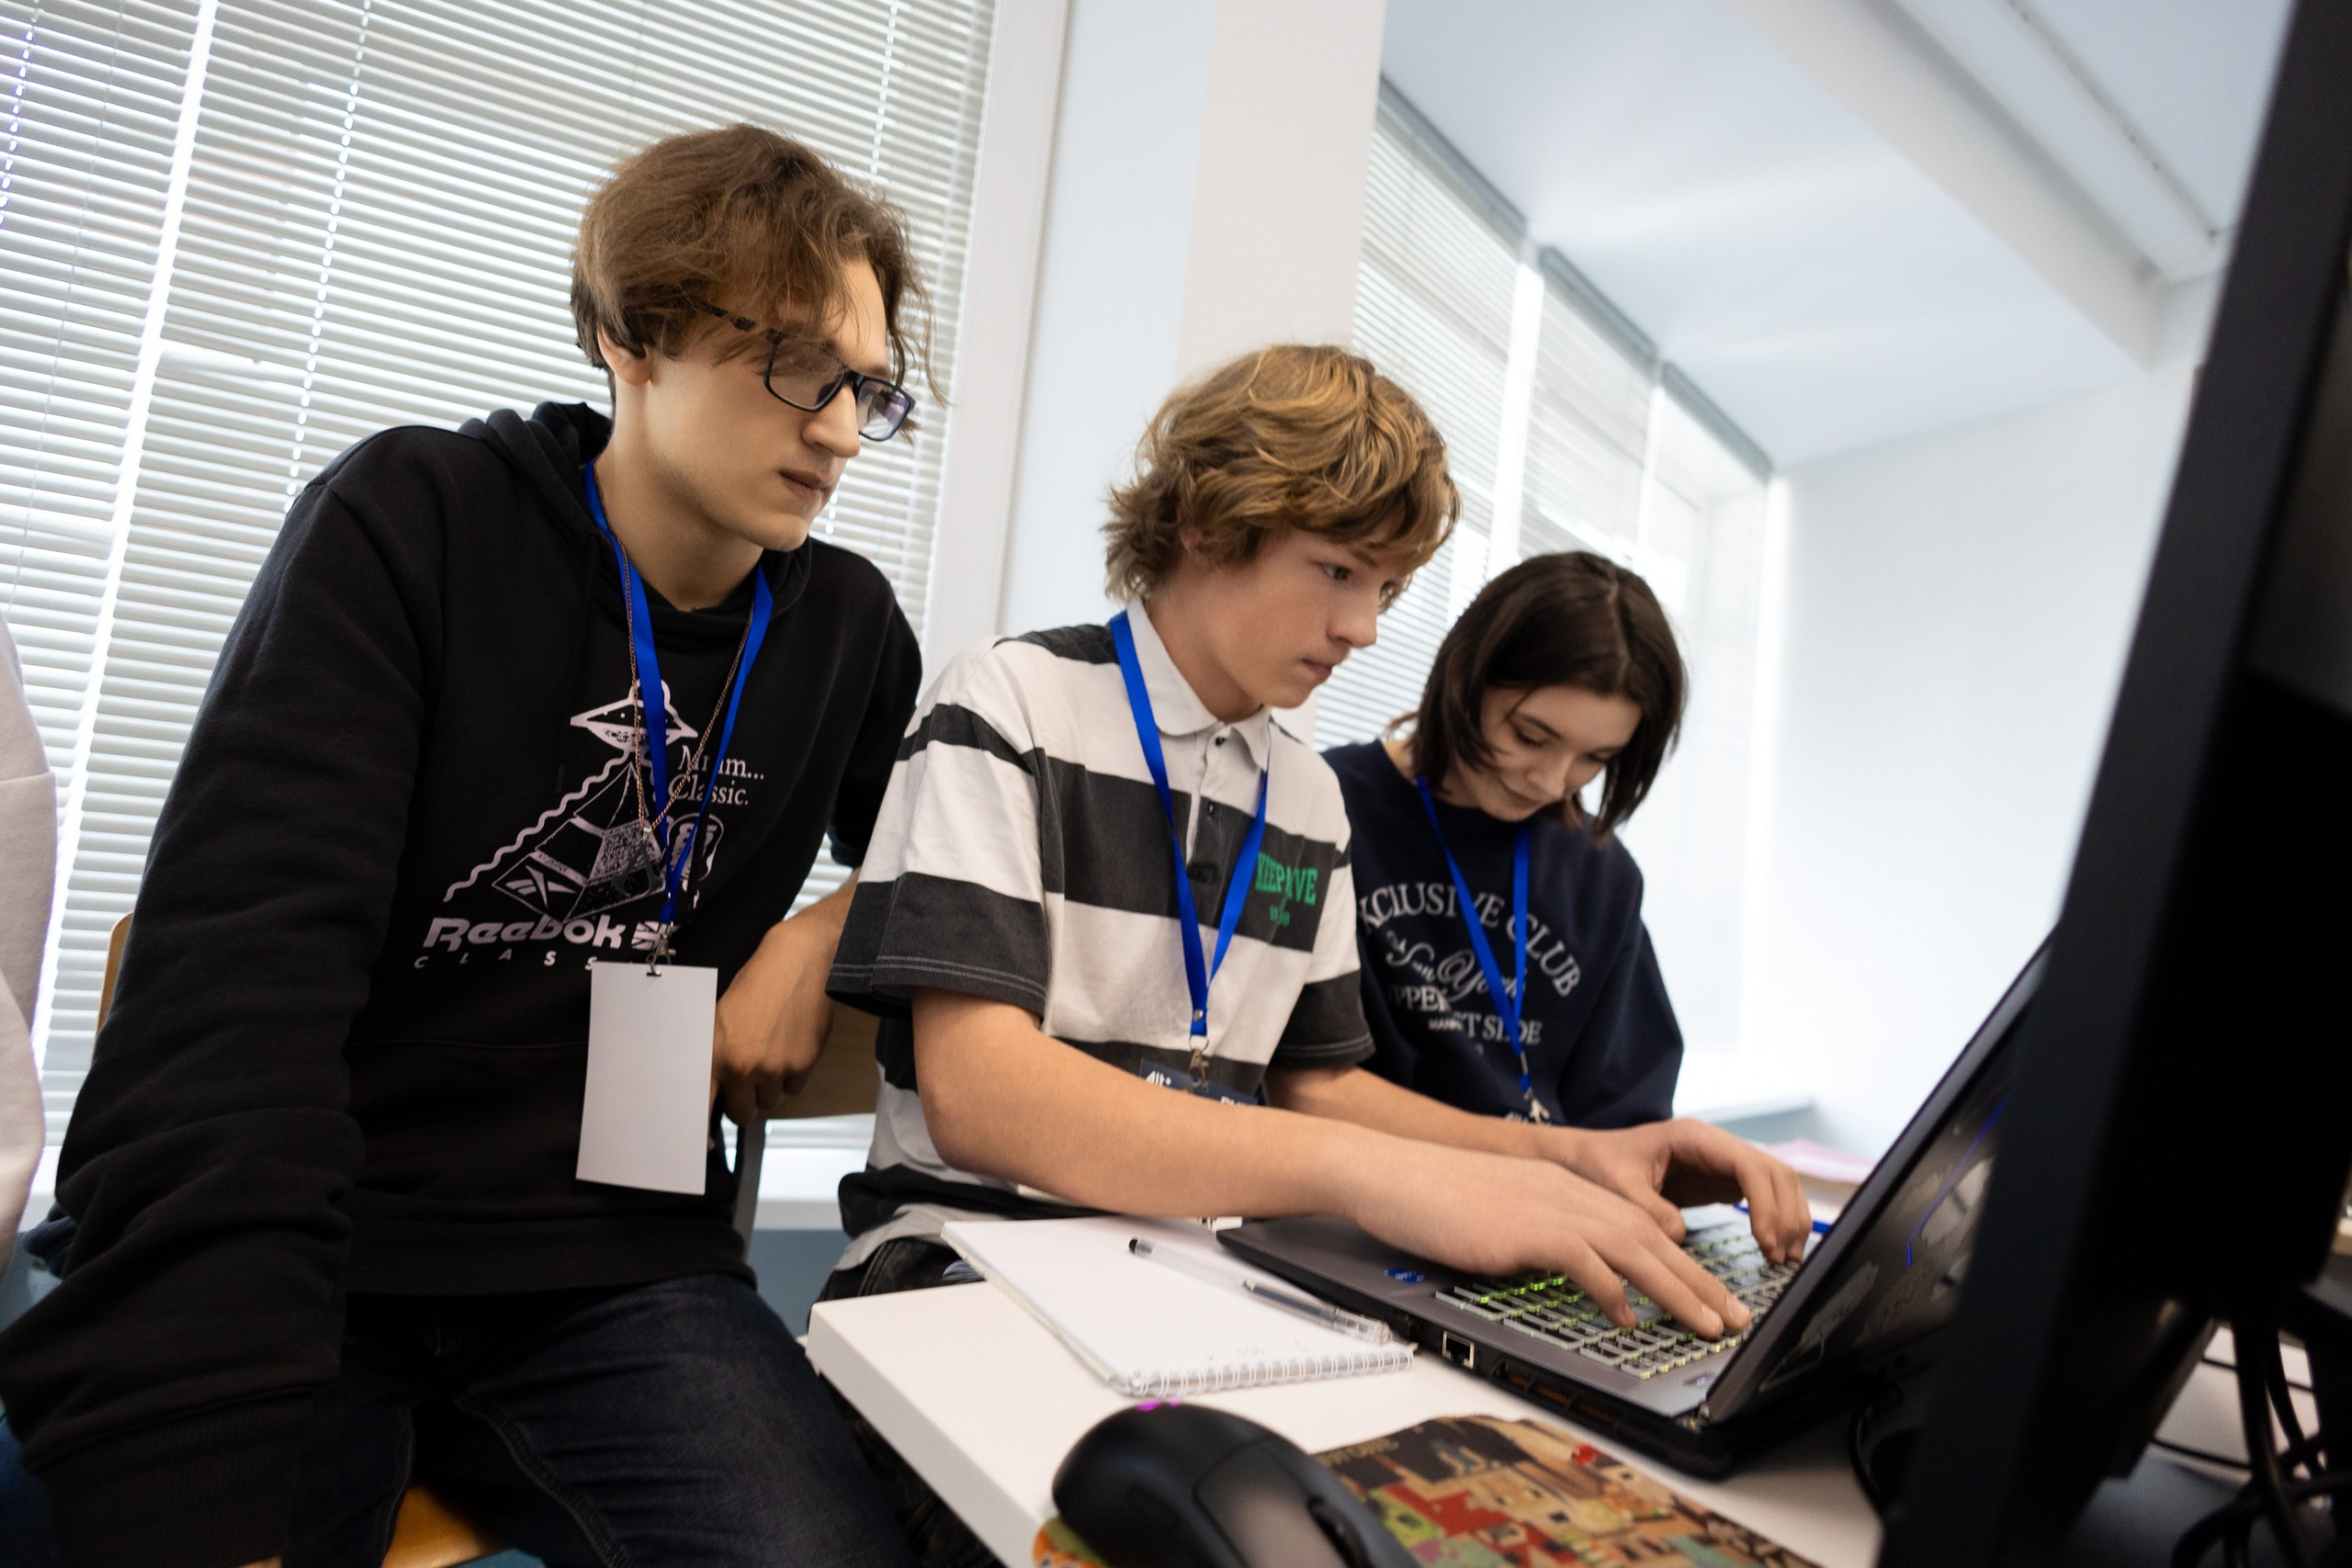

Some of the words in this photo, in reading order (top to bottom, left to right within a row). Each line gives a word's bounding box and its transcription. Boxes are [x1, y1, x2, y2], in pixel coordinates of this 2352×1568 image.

[423, 914, 627, 953] Reebok
[1358, 882, 1505, 932] XCLUSIE
[1507, 912, 1582, 998] CLUB
[413, 948, 655, 971] CLASS
